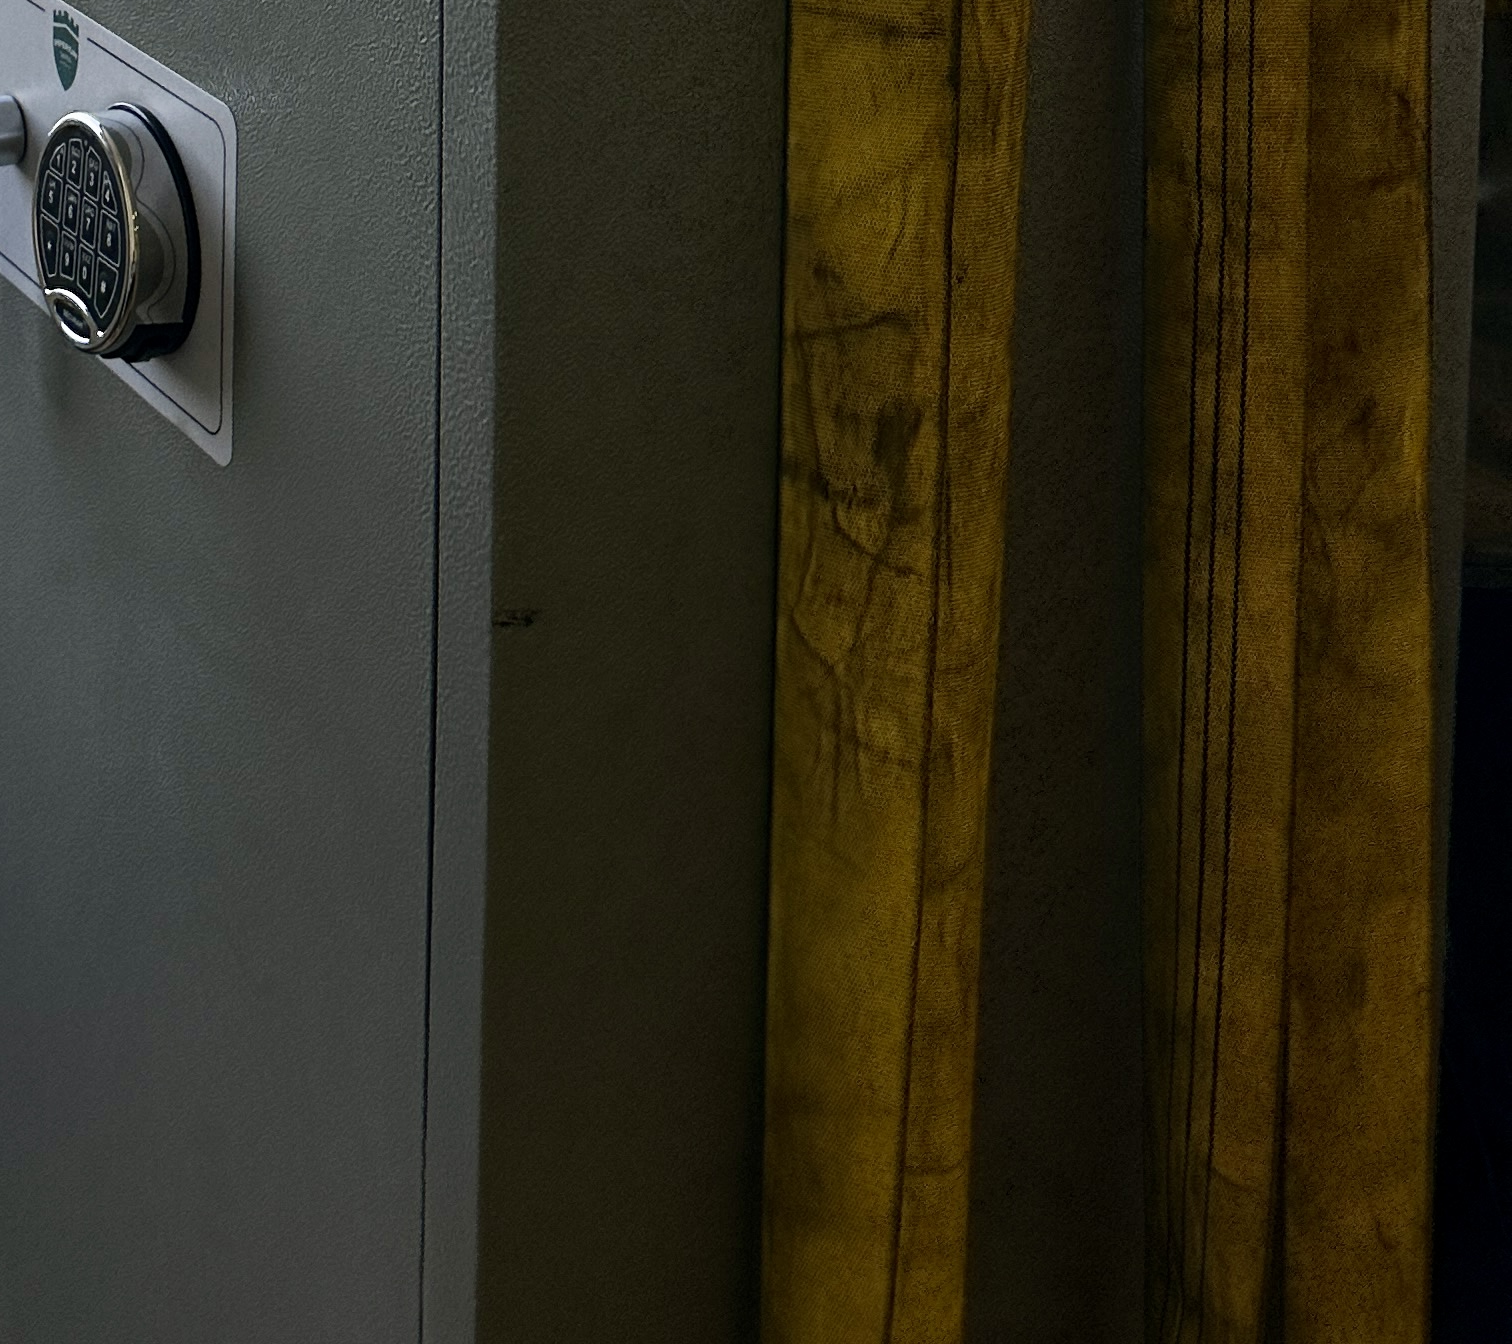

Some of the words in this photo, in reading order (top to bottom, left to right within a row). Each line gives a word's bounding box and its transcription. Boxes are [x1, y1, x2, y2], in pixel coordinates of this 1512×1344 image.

[71, 160, 78, 175] 2
[89, 172, 95, 187] 3
[48, 190, 54, 204] 5
[68, 204, 73, 219] 6
[106, 232, 112, 248] 8
[64, 252, 70, 267] 9
[82, 265, 87, 280] 0
